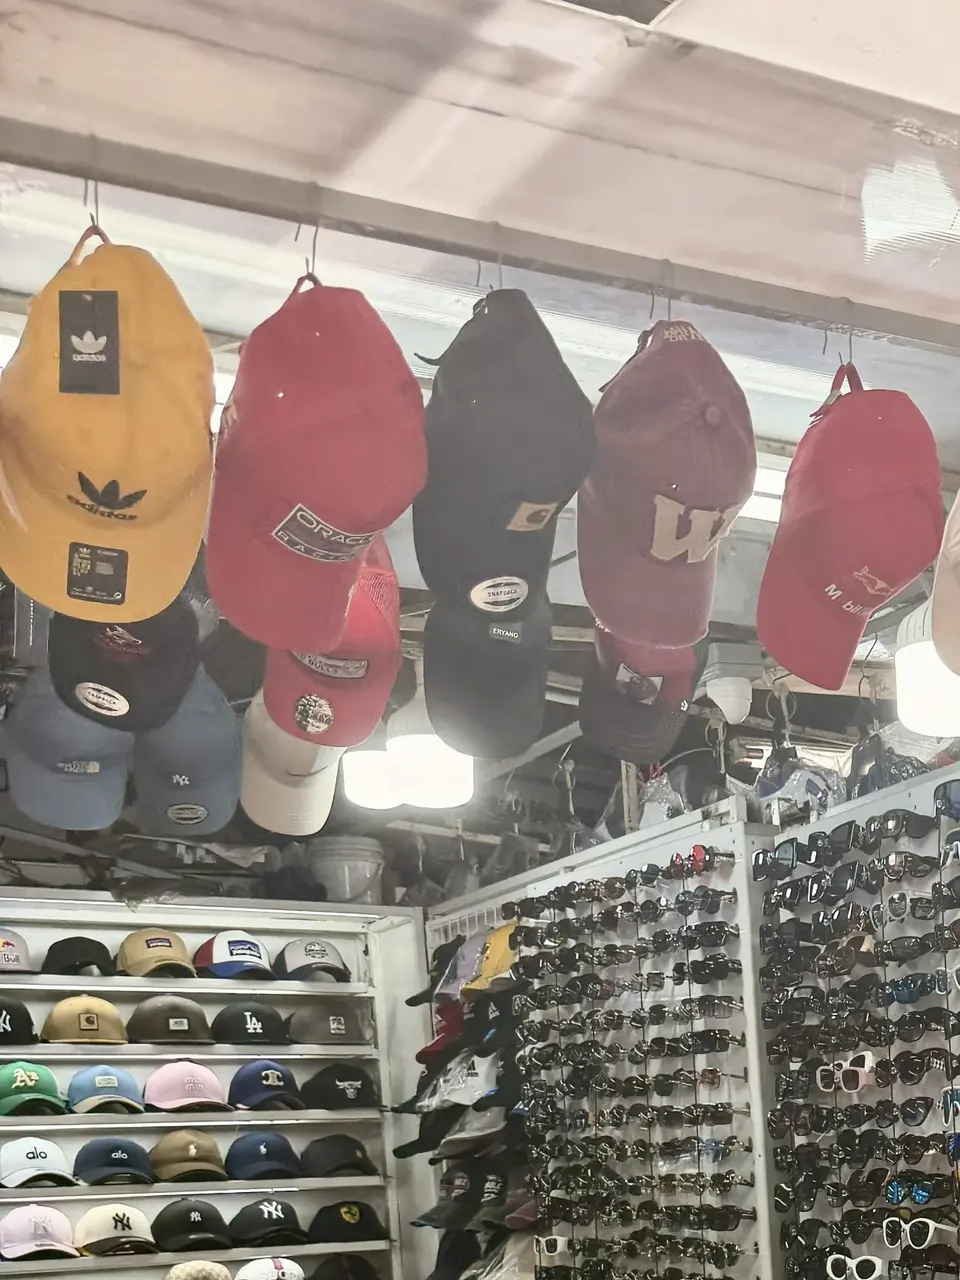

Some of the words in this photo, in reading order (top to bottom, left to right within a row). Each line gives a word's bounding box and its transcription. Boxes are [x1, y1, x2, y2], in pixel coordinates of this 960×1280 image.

[244, 1011, 263, 1033] LA
[25, 1147, 48, 1160] alo
[111, 1150, 129, 1160] alo
